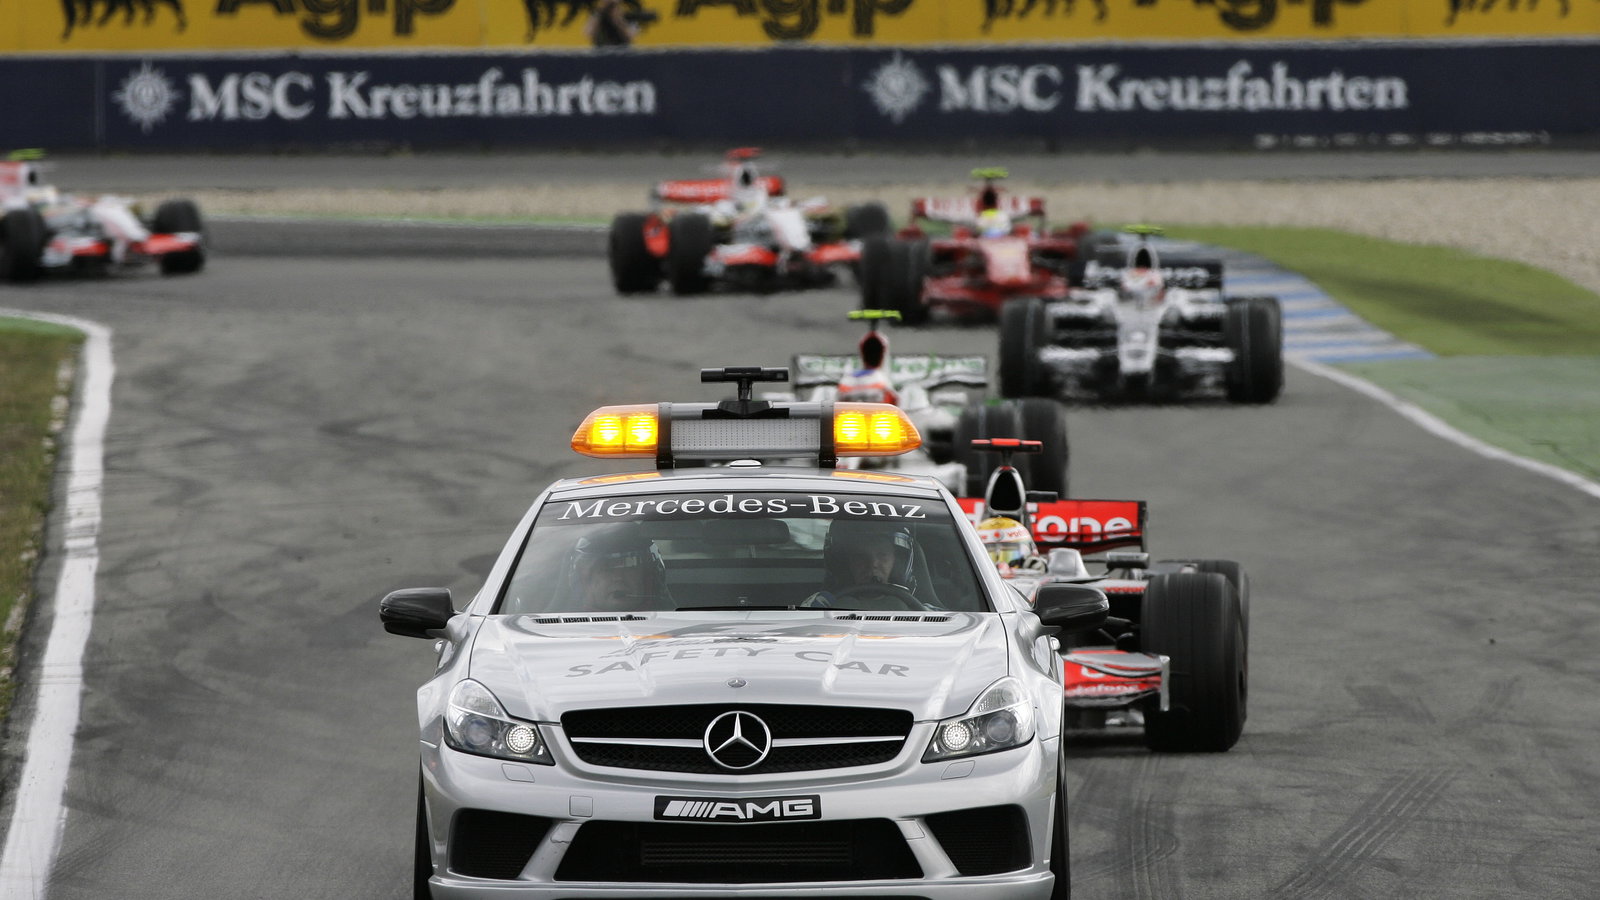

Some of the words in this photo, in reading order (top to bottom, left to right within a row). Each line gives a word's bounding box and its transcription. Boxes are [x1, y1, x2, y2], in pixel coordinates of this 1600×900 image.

[188, 71, 314, 120] MSC
[326, 65, 655, 119] Kreuzfahrten
[936, 63, 1063, 113] MSC
[1075, 59, 1408, 112] Kreuzfahrten
[557, 494, 926, 521] Mercedes-Benz
[565, 647, 774, 678] SAFETY
[794, 650, 910, 677] CAR
[708, 799, 814, 819] AMG
